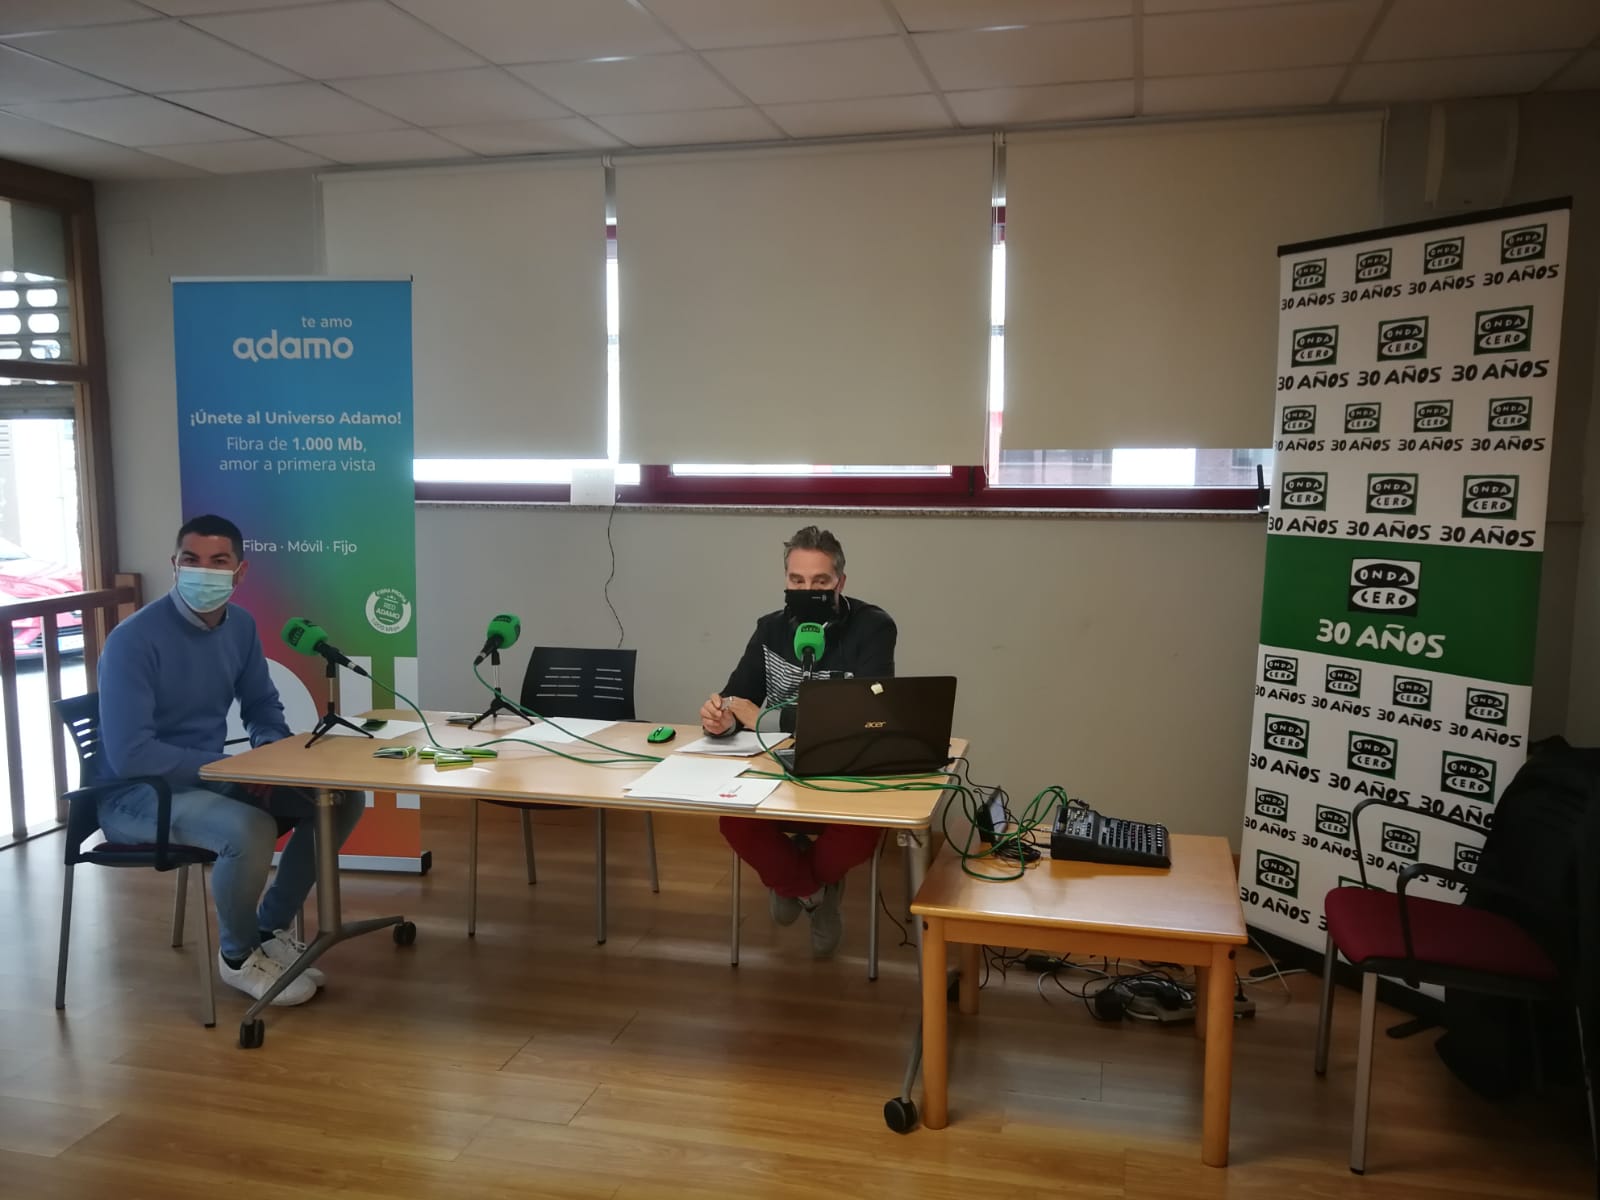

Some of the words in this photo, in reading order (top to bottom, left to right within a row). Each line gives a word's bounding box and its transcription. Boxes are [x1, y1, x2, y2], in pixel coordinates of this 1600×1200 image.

[1507, 232, 1540, 245] ONDA
[1430, 244, 1458, 257] ONDA
[1508, 244, 1538, 257] CERO
[1429, 256, 1456, 269] CERO
[1483, 272, 1504, 286] 30
[1508, 264, 1560, 282] AÑOS
[1408, 282, 1426, 295] 30
[1429, 275, 1475, 293] AÑOS
[1341, 290, 1357, 303] 30
[1360, 284, 1401, 300] AÑOS
[1281, 298, 1294, 310] 30
[1296, 293, 1335, 308] AÑOS
[302, 316, 315, 328] te
[321, 318, 353, 328] amo
[1485, 316, 1521, 329] ONDA
[1387, 326, 1418, 339] ONDA
[1485, 332, 1521, 346] CERO
[232, 329, 354, 362] adamo
[1300, 334, 1329, 346] ONDA
[1387, 340, 1417, 353] CERO
[1300, 348, 1329, 359] CERO
[1357, 371, 1380, 386] 30
[1384, 365, 1442, 385] AÑOS
[1452, 364, 1478, 381] 30
[1482, 359, 1550, 380] AÑOS
[1278, 376, 1294, 390] 30
[1298, 371, 1349, 389] AÑOS
[1421, 407, 1445, 416] ONDA
[1496, 404, 1524, 413] ONDA
[190, 409, 242, 427] ¡Únete
[247, 411, 260, 424] al
[266, 411, 334, 424] Universo
[339, 411, 401, 424] Adamo!
[1420, 417, 1444, 427] CERO
[1497, 416, 1523, 425] CERO
[227, 437, 263, 451] Fibra
[269, 437, 287, 451] de
[293, 438, 333, 451] 1.000
[338, 437, 367, 452] Mb,
[1286, 438, 1325, 451] AÑOS
[1331, 439, 1346, 451] 30
[1350, 437, 1390, 451] AÑOS
[1398, 439, 1416, 451] 30
[1420, 437, 1464, 451] AÑOS
[1471, 438, 1490, 451] 30
[1494, 436, 1545, 451] AÑOS
[220, 459, 258, 471] amor
[263, 460, 272, 471] a
[278, 458, 336, 474] primera
[341, 458, 376, 471] vista
[1289, 480, 1320, 489] ONDA
[1375, 483, 1408, 492] ONDA
[1473, 485, 1507, 496] ONDA
[1289, 493, 1320, 503] CERO
[1376, 497, 1408, 506] CERO
[1473, 500, 1506, 510] CERO
[1269, 517, 1283, 531] 30
[1286, 516, 1338, 534] AÑOS
[1346, 521, 1369, 537] 30
[1373, 521, 1431, 540] AÑOS
[1440, 526, 1465, 543] 30
[1469, 526, 1536, 547] AÑOS
[243, 540, 276, 552] Fibra
[288, 540, 323, 552] Móvil
[334, 540, 357, 555] Fijo
[1360, 569, 1410, 582] ONDA
[1361, 590, 1407, 605] CERO
[376, 608, 400, 619] ADAMO
[1316, 618, 1350, 644] 30
[1356, 624, 1446, 658] AÑOS
[1269, 660, 1292, 669] ONDA
[1269, 671, 1292, 680] CERO
[1331, 671, 1356, 680] ONDA
[1332, 682, 1355, 691] CERO
[1399, 683, 1426, 693] ONDA
[1268, 688, 1306, 704] AÑOS
[1400, 694, 1424, 704] CERO
[1472, 695, 1501, 707] ONDA
[1312, 696, 1327, 709] 30
[1330, 700, 1370, 718] AÑOS
[1474, 708, 1500, 718] CERO
[864, 720, 886, 728] acer
[1377, 709, 1395, 722] 30
[1398, 713, 1442, 732] AÑOS
[1272, 723, 1303, 734] ONDA
[1273, 735, 1300, 748] CERO
[1449, 723, 1468, 736] 30
[1470, 728, 1522, 748] AÑOS
[1356, 742, 1389, 754] ONDA
[1250, 754, 1266, 769] 30
[1270, 760, 1320, 783] AÑOS
[1357, 756, 1387, 768] CERO
[1451, 762, 1486, 776] ONDA
[1328, 773, 1350, 790] 30
[1354, 780, 1410, 807] AÑOS
[1452, 778, 1484, 792] CERO
[1320, 811, 1346, 824] ONDA
[1420, 796, 1444, 815] 30
[1449, 805, 1493, 829] AÑO
[1244, 816, 1257, 830] 30
[1260, 823, 1296, 841] AÑOS
[1322, 822, 1344, 834] CERO
[1387, 829, 1414, 842] ONDA
[1302, 834, 1318, 848] 30
[1320, 842, 1359, 860] AÑOS
[1388, 842, 1413, 854] CERO
[1264, 858, 1294, 874] ONDA
[1366, 854, 1384, 868] 30
[1460, 862, 1474, 872] CE
[1264, 873, 1290, 886] CERO
[1240, 887, 1258, 906] 30
[1262, 899, 1310, 924] AÑOS
[1318, 916, 1328, 932] 3
